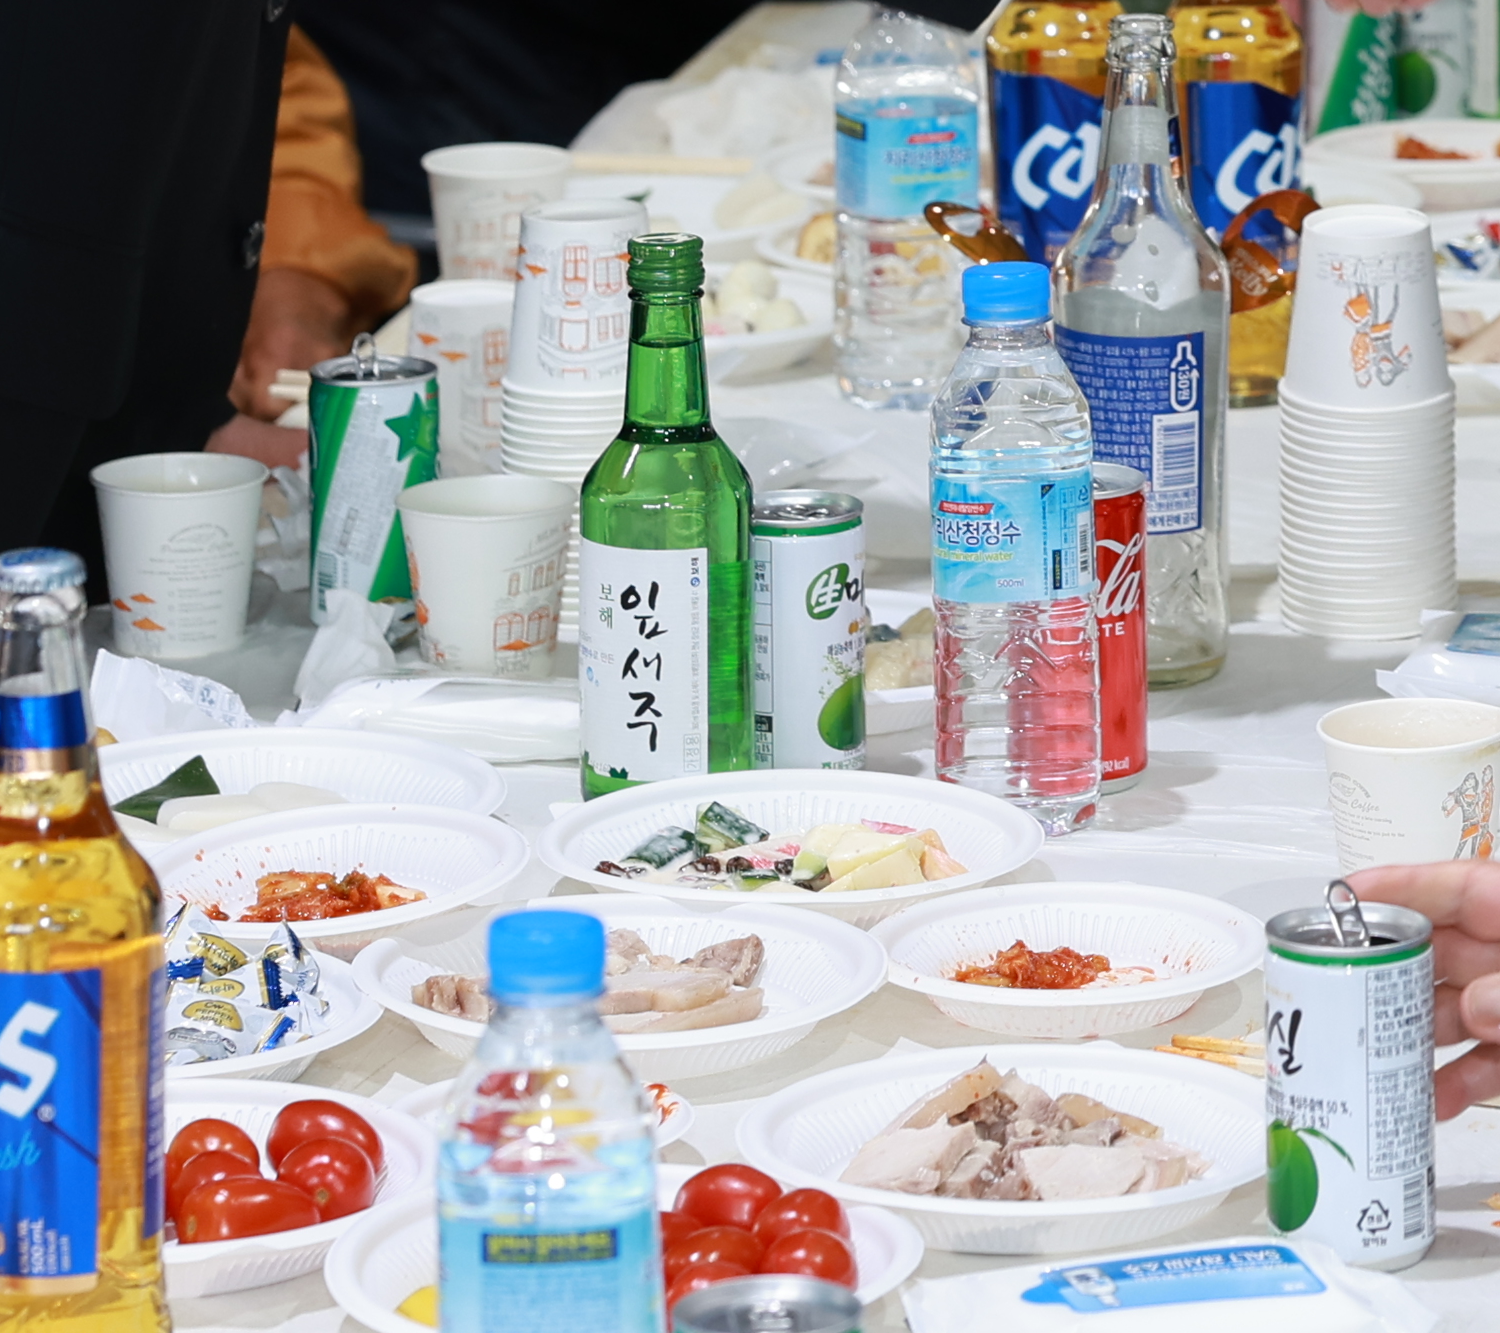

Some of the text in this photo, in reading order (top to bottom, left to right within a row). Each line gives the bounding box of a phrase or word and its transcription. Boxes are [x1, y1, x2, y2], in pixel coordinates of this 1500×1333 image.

[933, 517, 1022, 546] 리산청정수
[984, 550, 1014, 562] water
[996, 578, 1025, 589] 500ml
[598, 581, 616, 630] 보해
[619, 579, 669, 753] 잎새주
[1350, 798, 1380, 813] Coffee
[1268, 1007, 1304, 1076] 실
